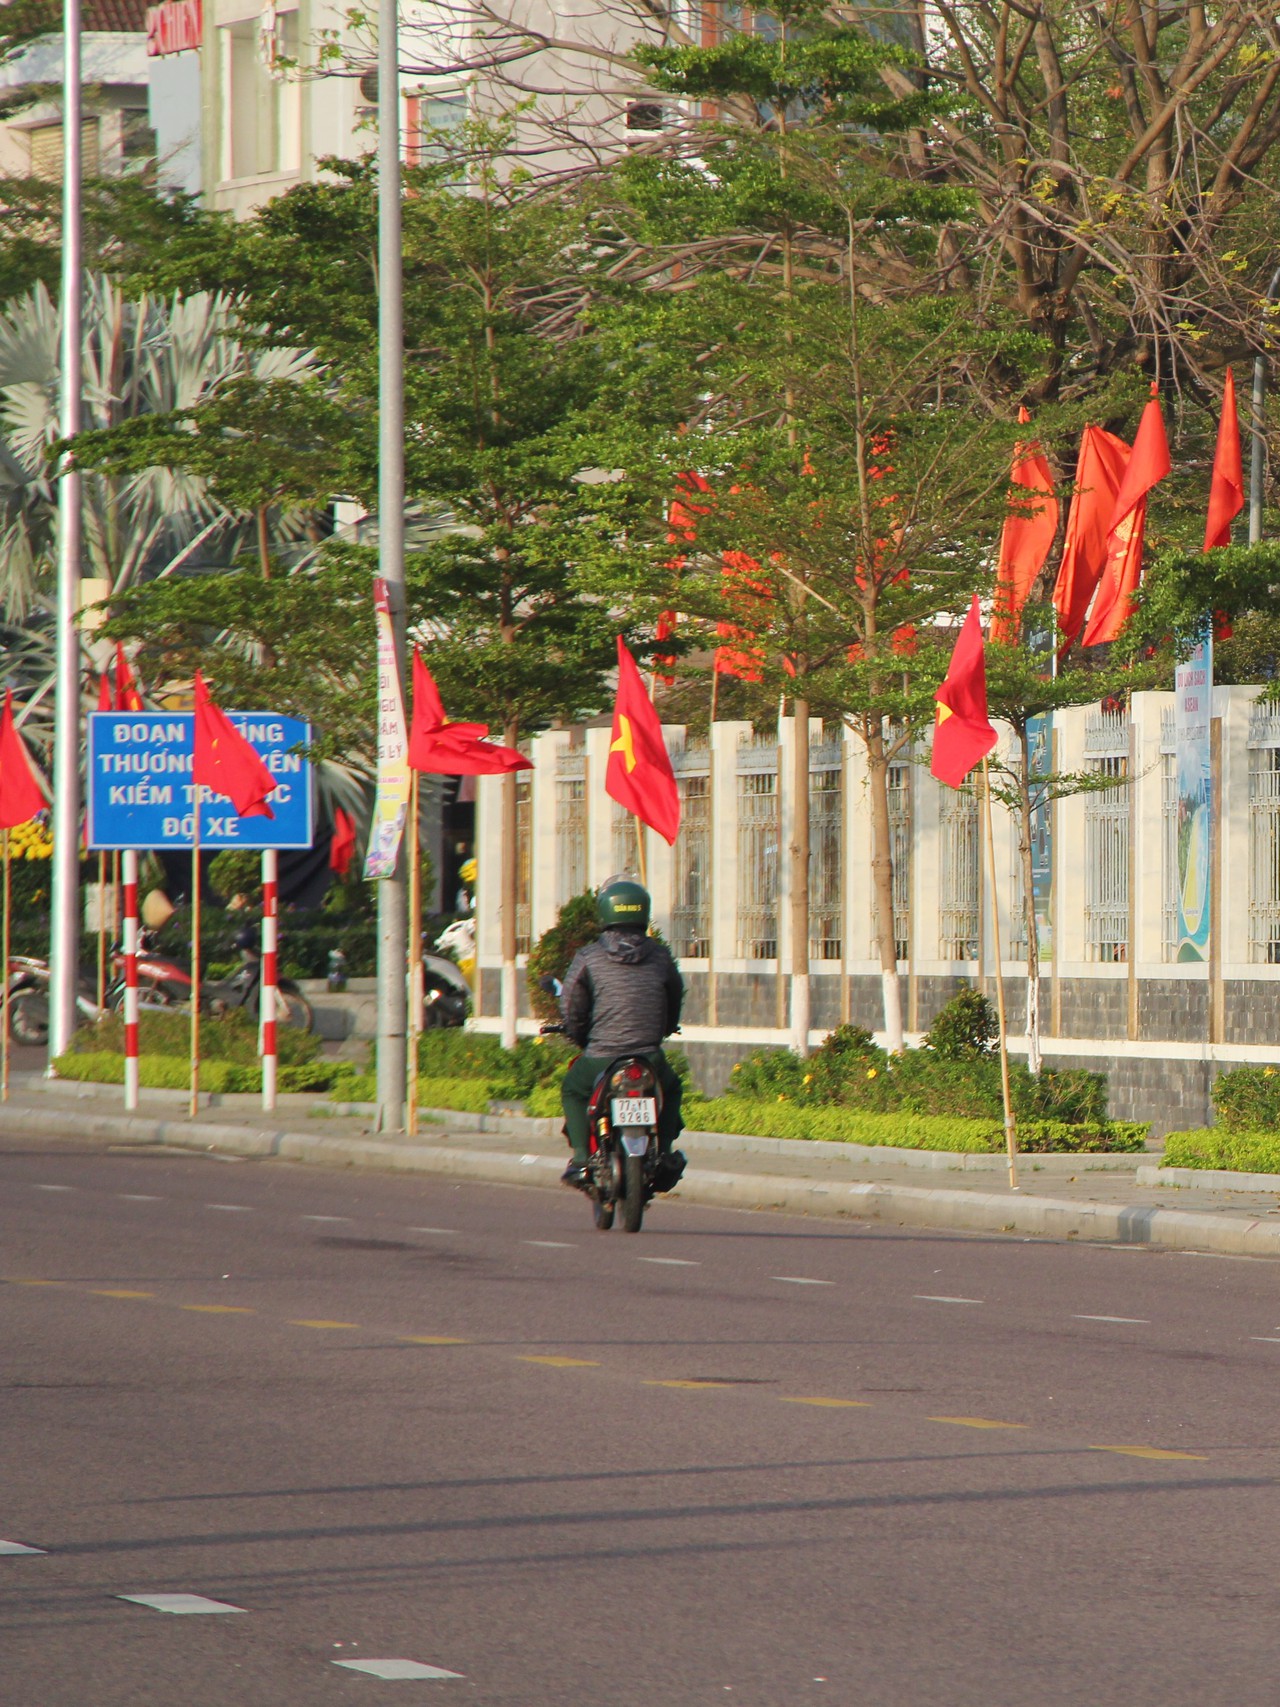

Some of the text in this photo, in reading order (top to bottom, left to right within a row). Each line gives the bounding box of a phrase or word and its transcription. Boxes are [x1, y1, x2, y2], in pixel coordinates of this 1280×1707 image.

[113, 723, 184, 747] ĐOẠN
[110, 775, 172, 805] KIỂM
[206, 816, 240, 837] XE
